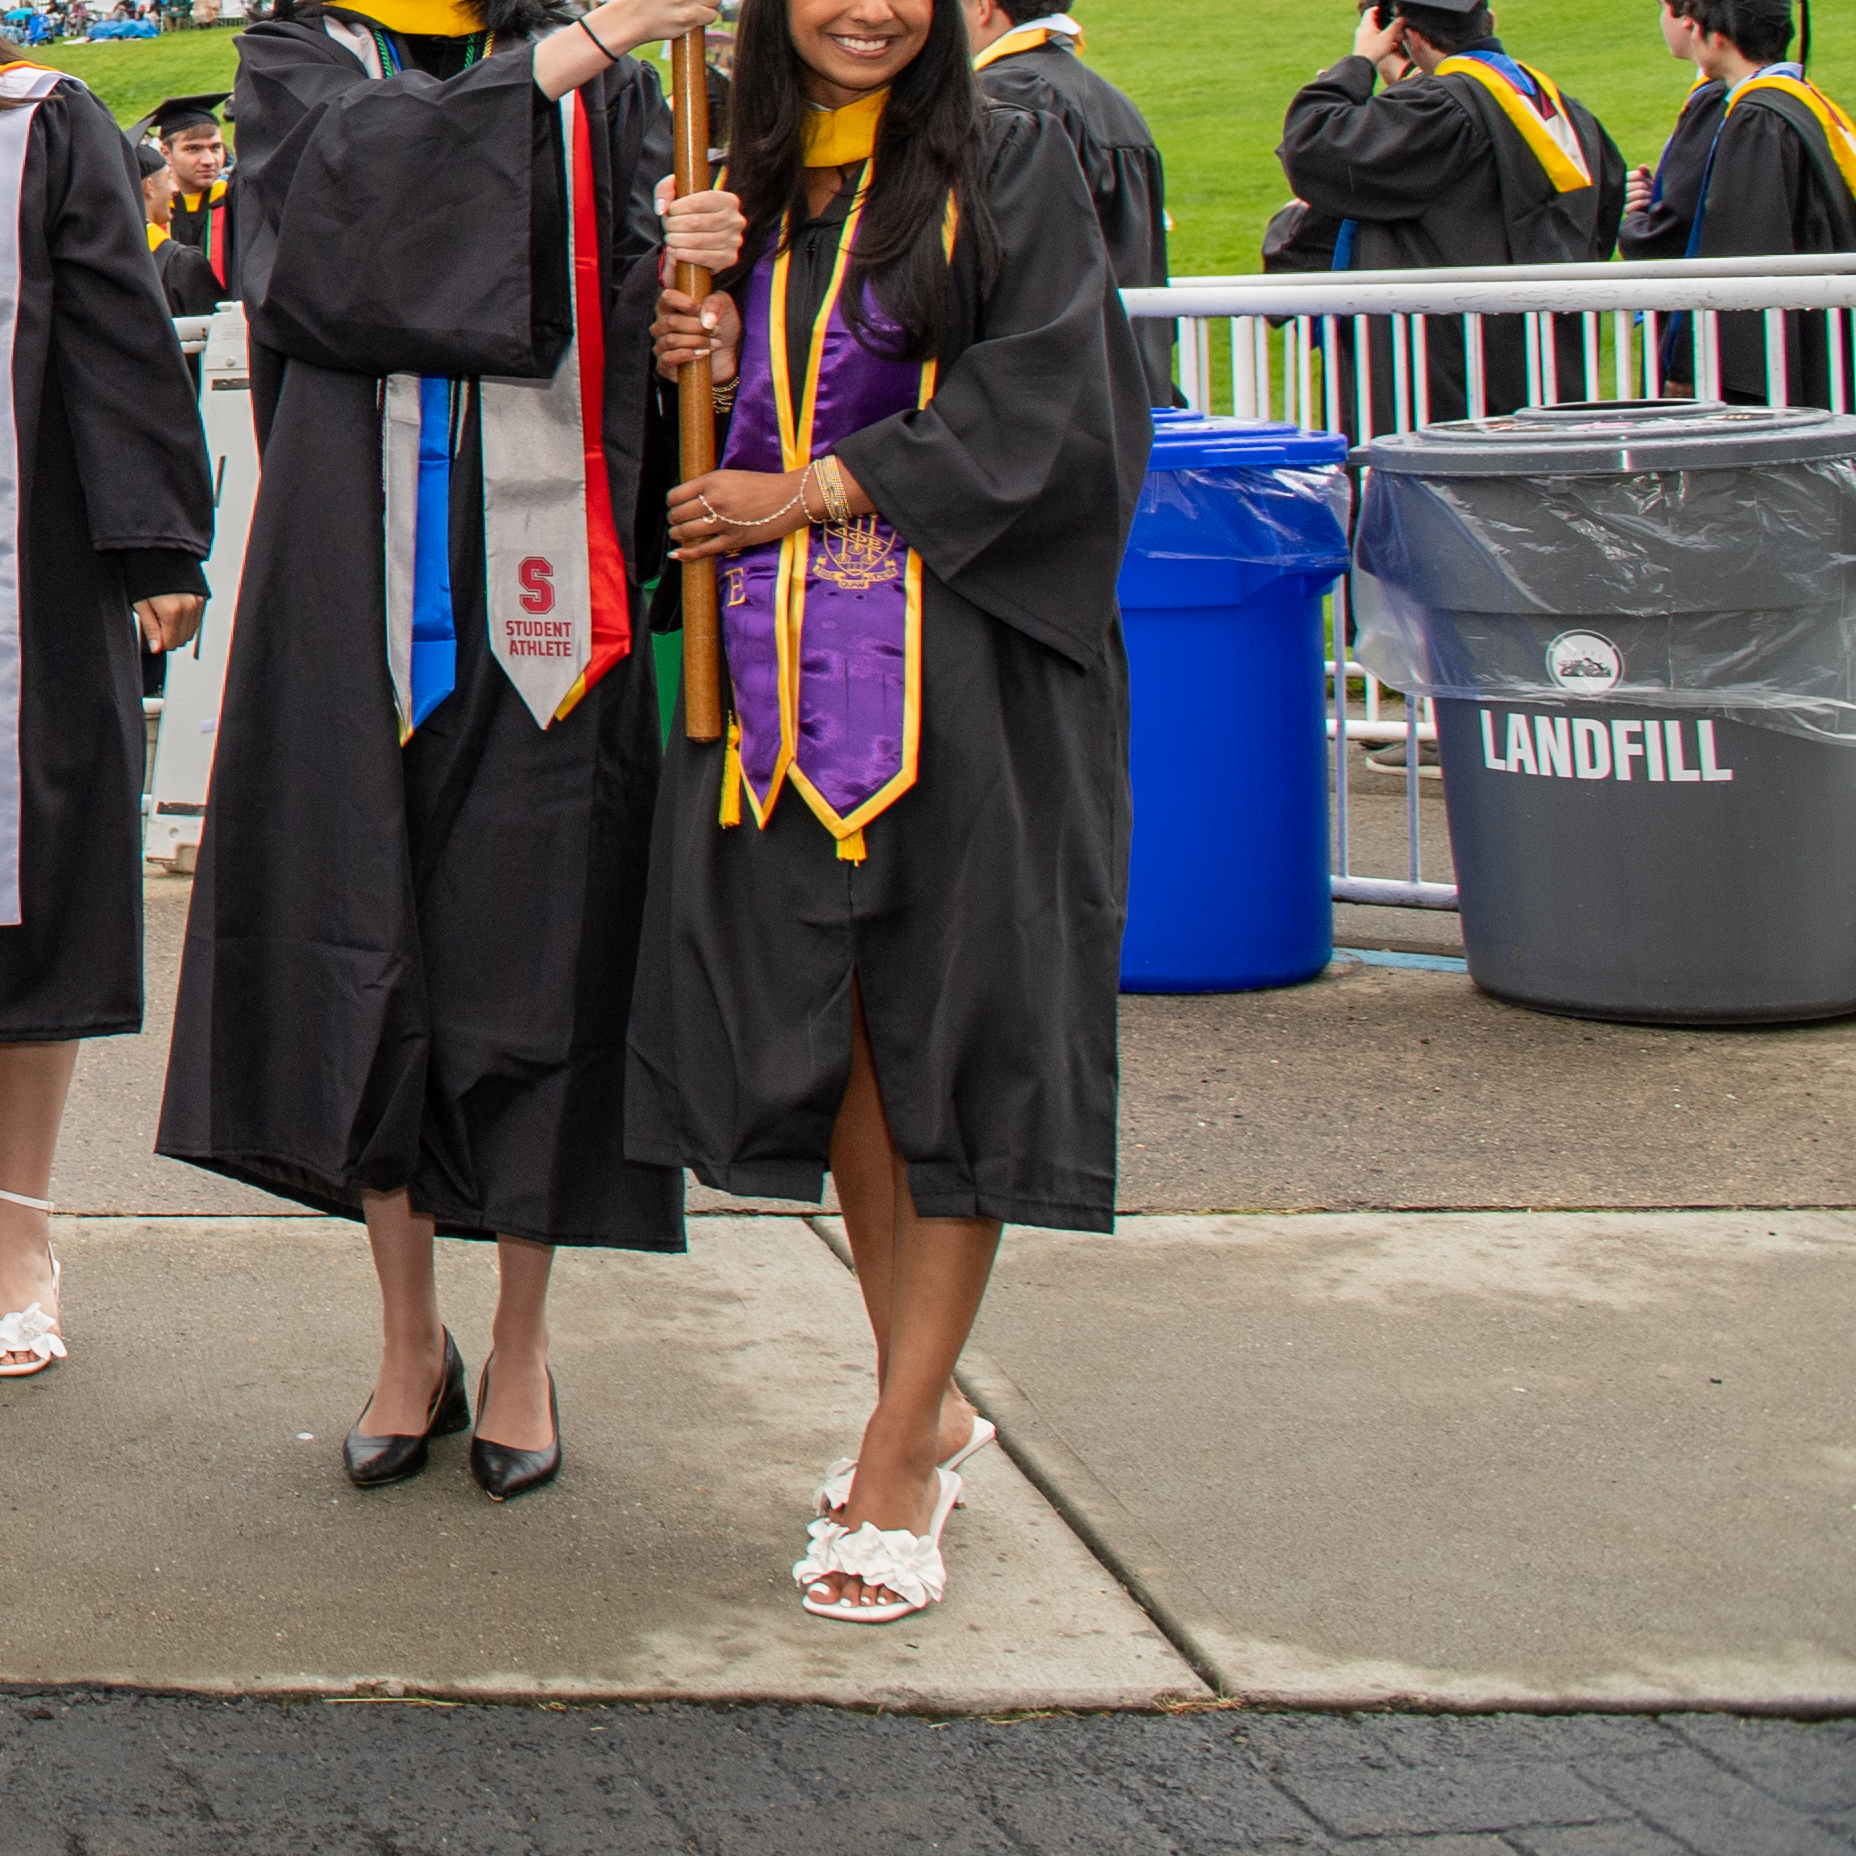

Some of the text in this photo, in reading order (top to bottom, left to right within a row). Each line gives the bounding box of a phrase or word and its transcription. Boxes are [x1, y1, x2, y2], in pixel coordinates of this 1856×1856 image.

[517, 555, 556, 615] S
[505, 620, 572, 638] STUDENT
[509, 640, 572, 658] ATHLETE
[1480, 709, 1733, 781] LANDFILL
